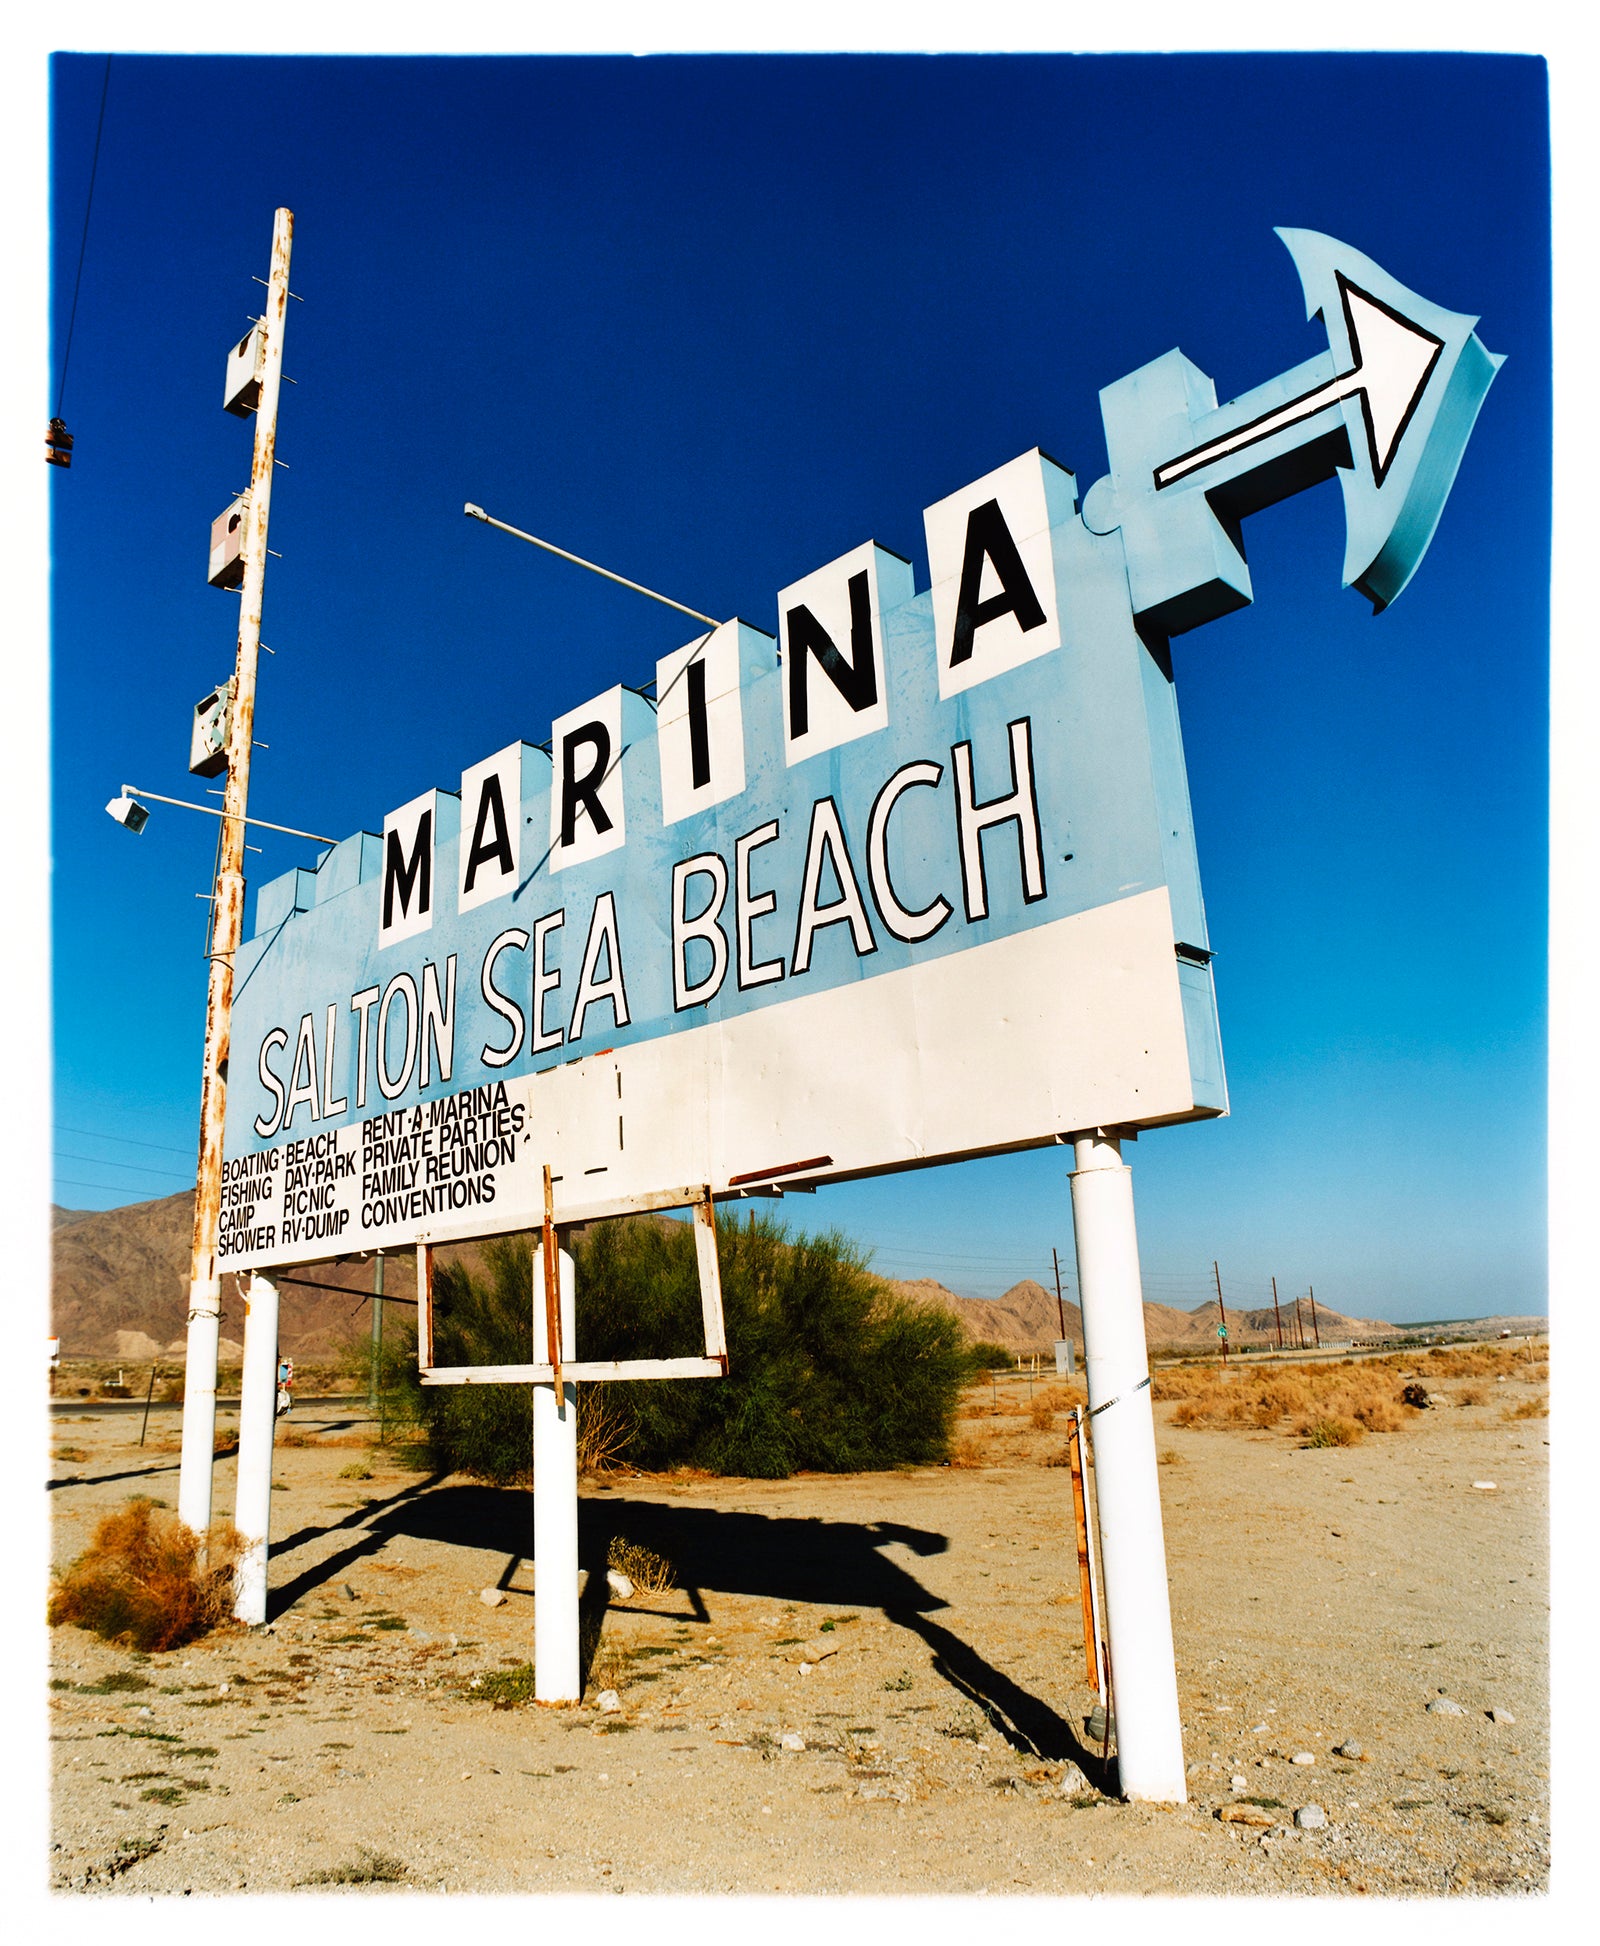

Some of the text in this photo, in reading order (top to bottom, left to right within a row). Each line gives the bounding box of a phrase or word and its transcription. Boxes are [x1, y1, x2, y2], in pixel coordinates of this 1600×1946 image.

[382, 497, 1047, 931] MARINA
[253, 715, 1046, 1139] SALTON SEA BEACH
[362, 1103, 526, 1173] PRIVATE PARTIES
[220, 1176, 273, 1208] FISHING
[362, 1134, 516, 1201] FAMILY REUNION
[218, 1204, 255, 1233] CAMP
[283, 1183, 336, 1218] PICNIC
[361, 1173, 497, 1229] CONVENTIONS
[218, 1225, 276, 1258] SHOWER
